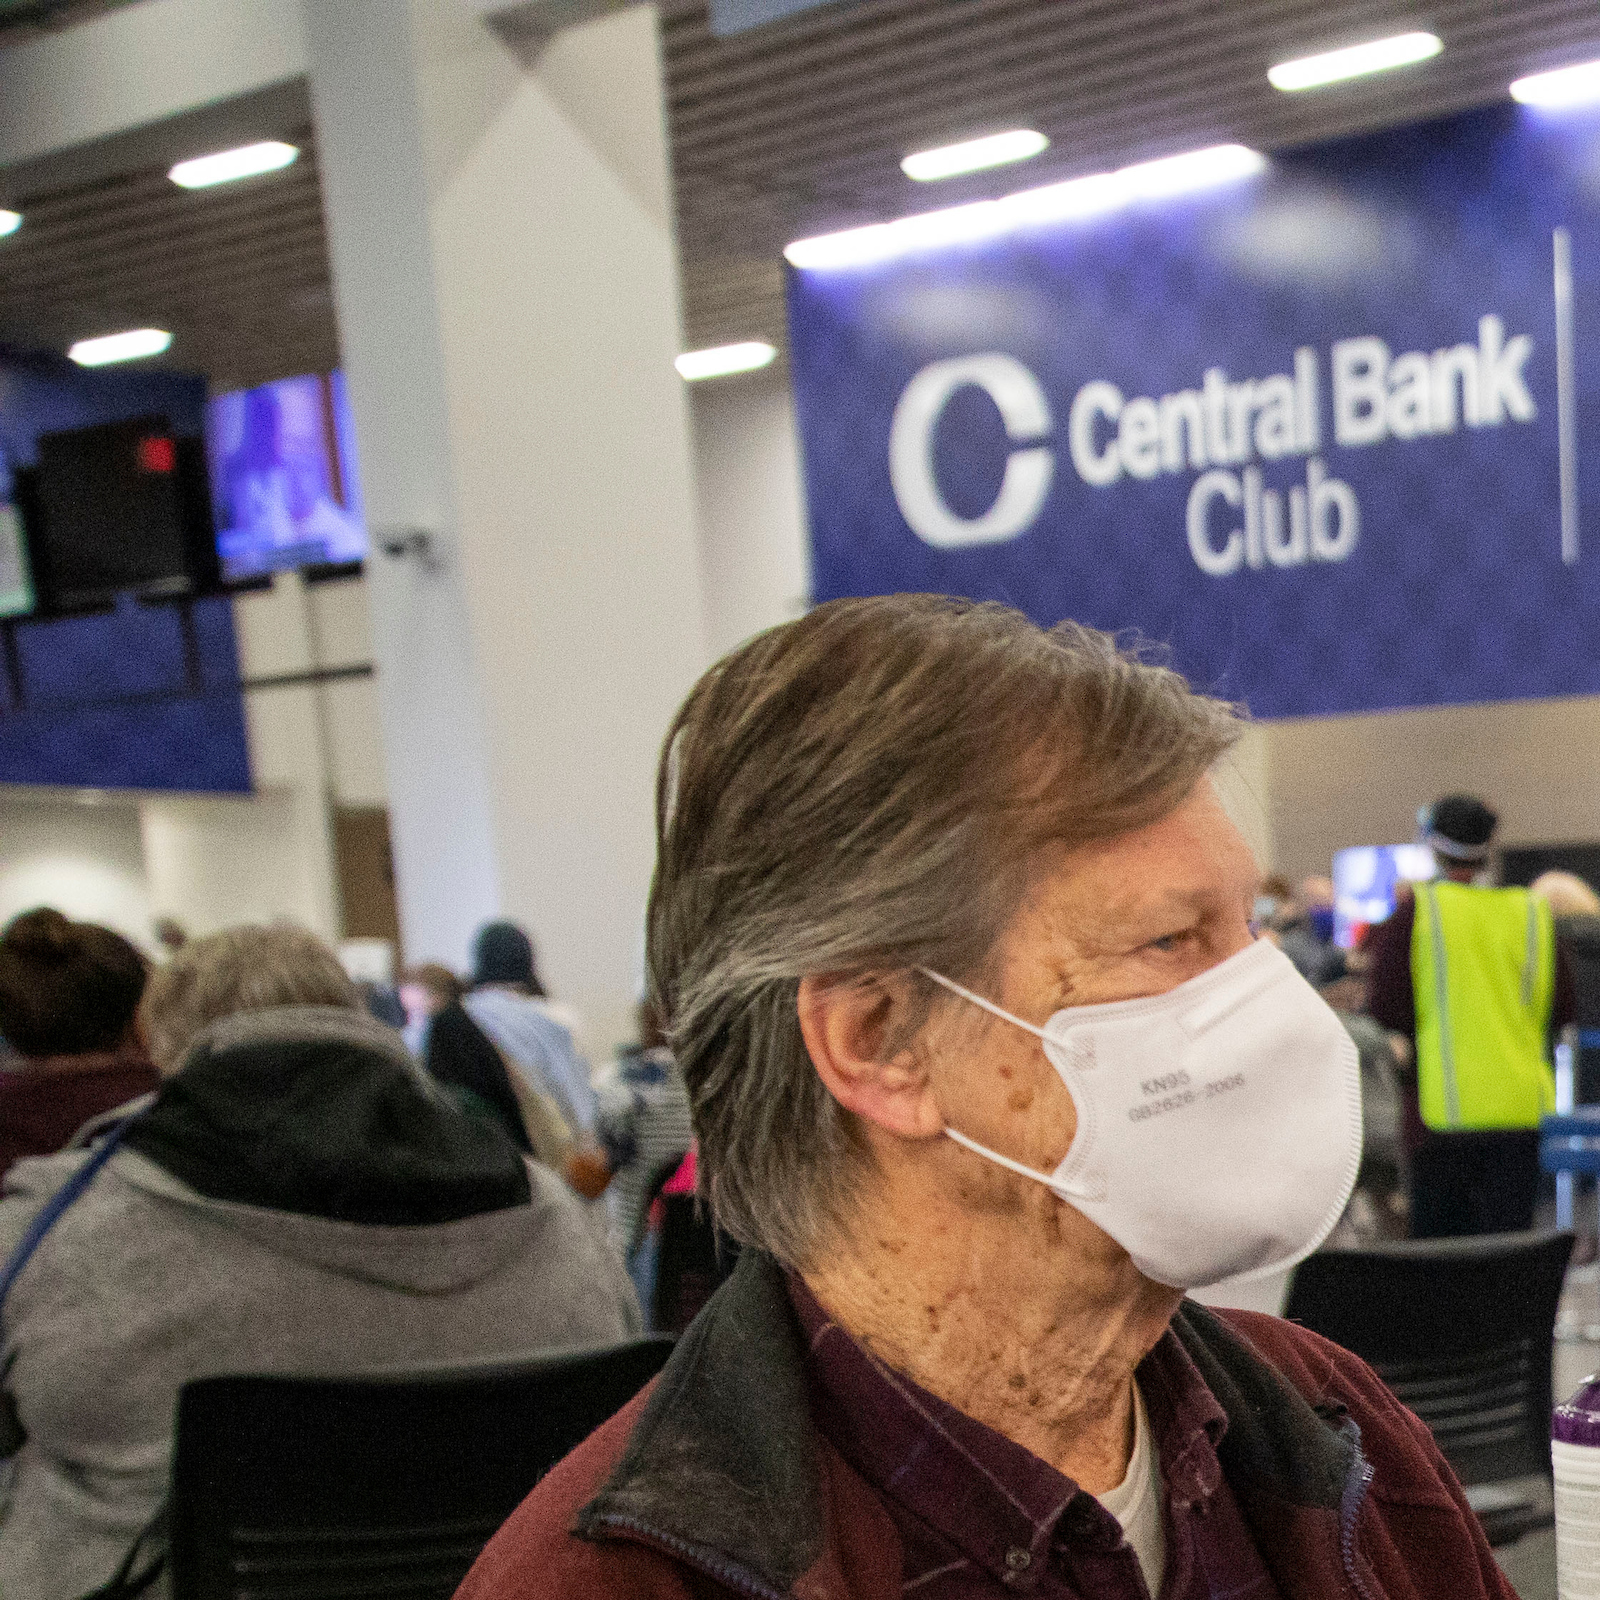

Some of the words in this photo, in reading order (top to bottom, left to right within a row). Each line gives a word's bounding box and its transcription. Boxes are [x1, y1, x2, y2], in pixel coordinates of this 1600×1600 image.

[889, 351, 1054, 550] C
[1069, 345, 1321, 486] Central
[1331, 313, 1537, 446] Bank
[1186, 456, 1360, 577] Club
